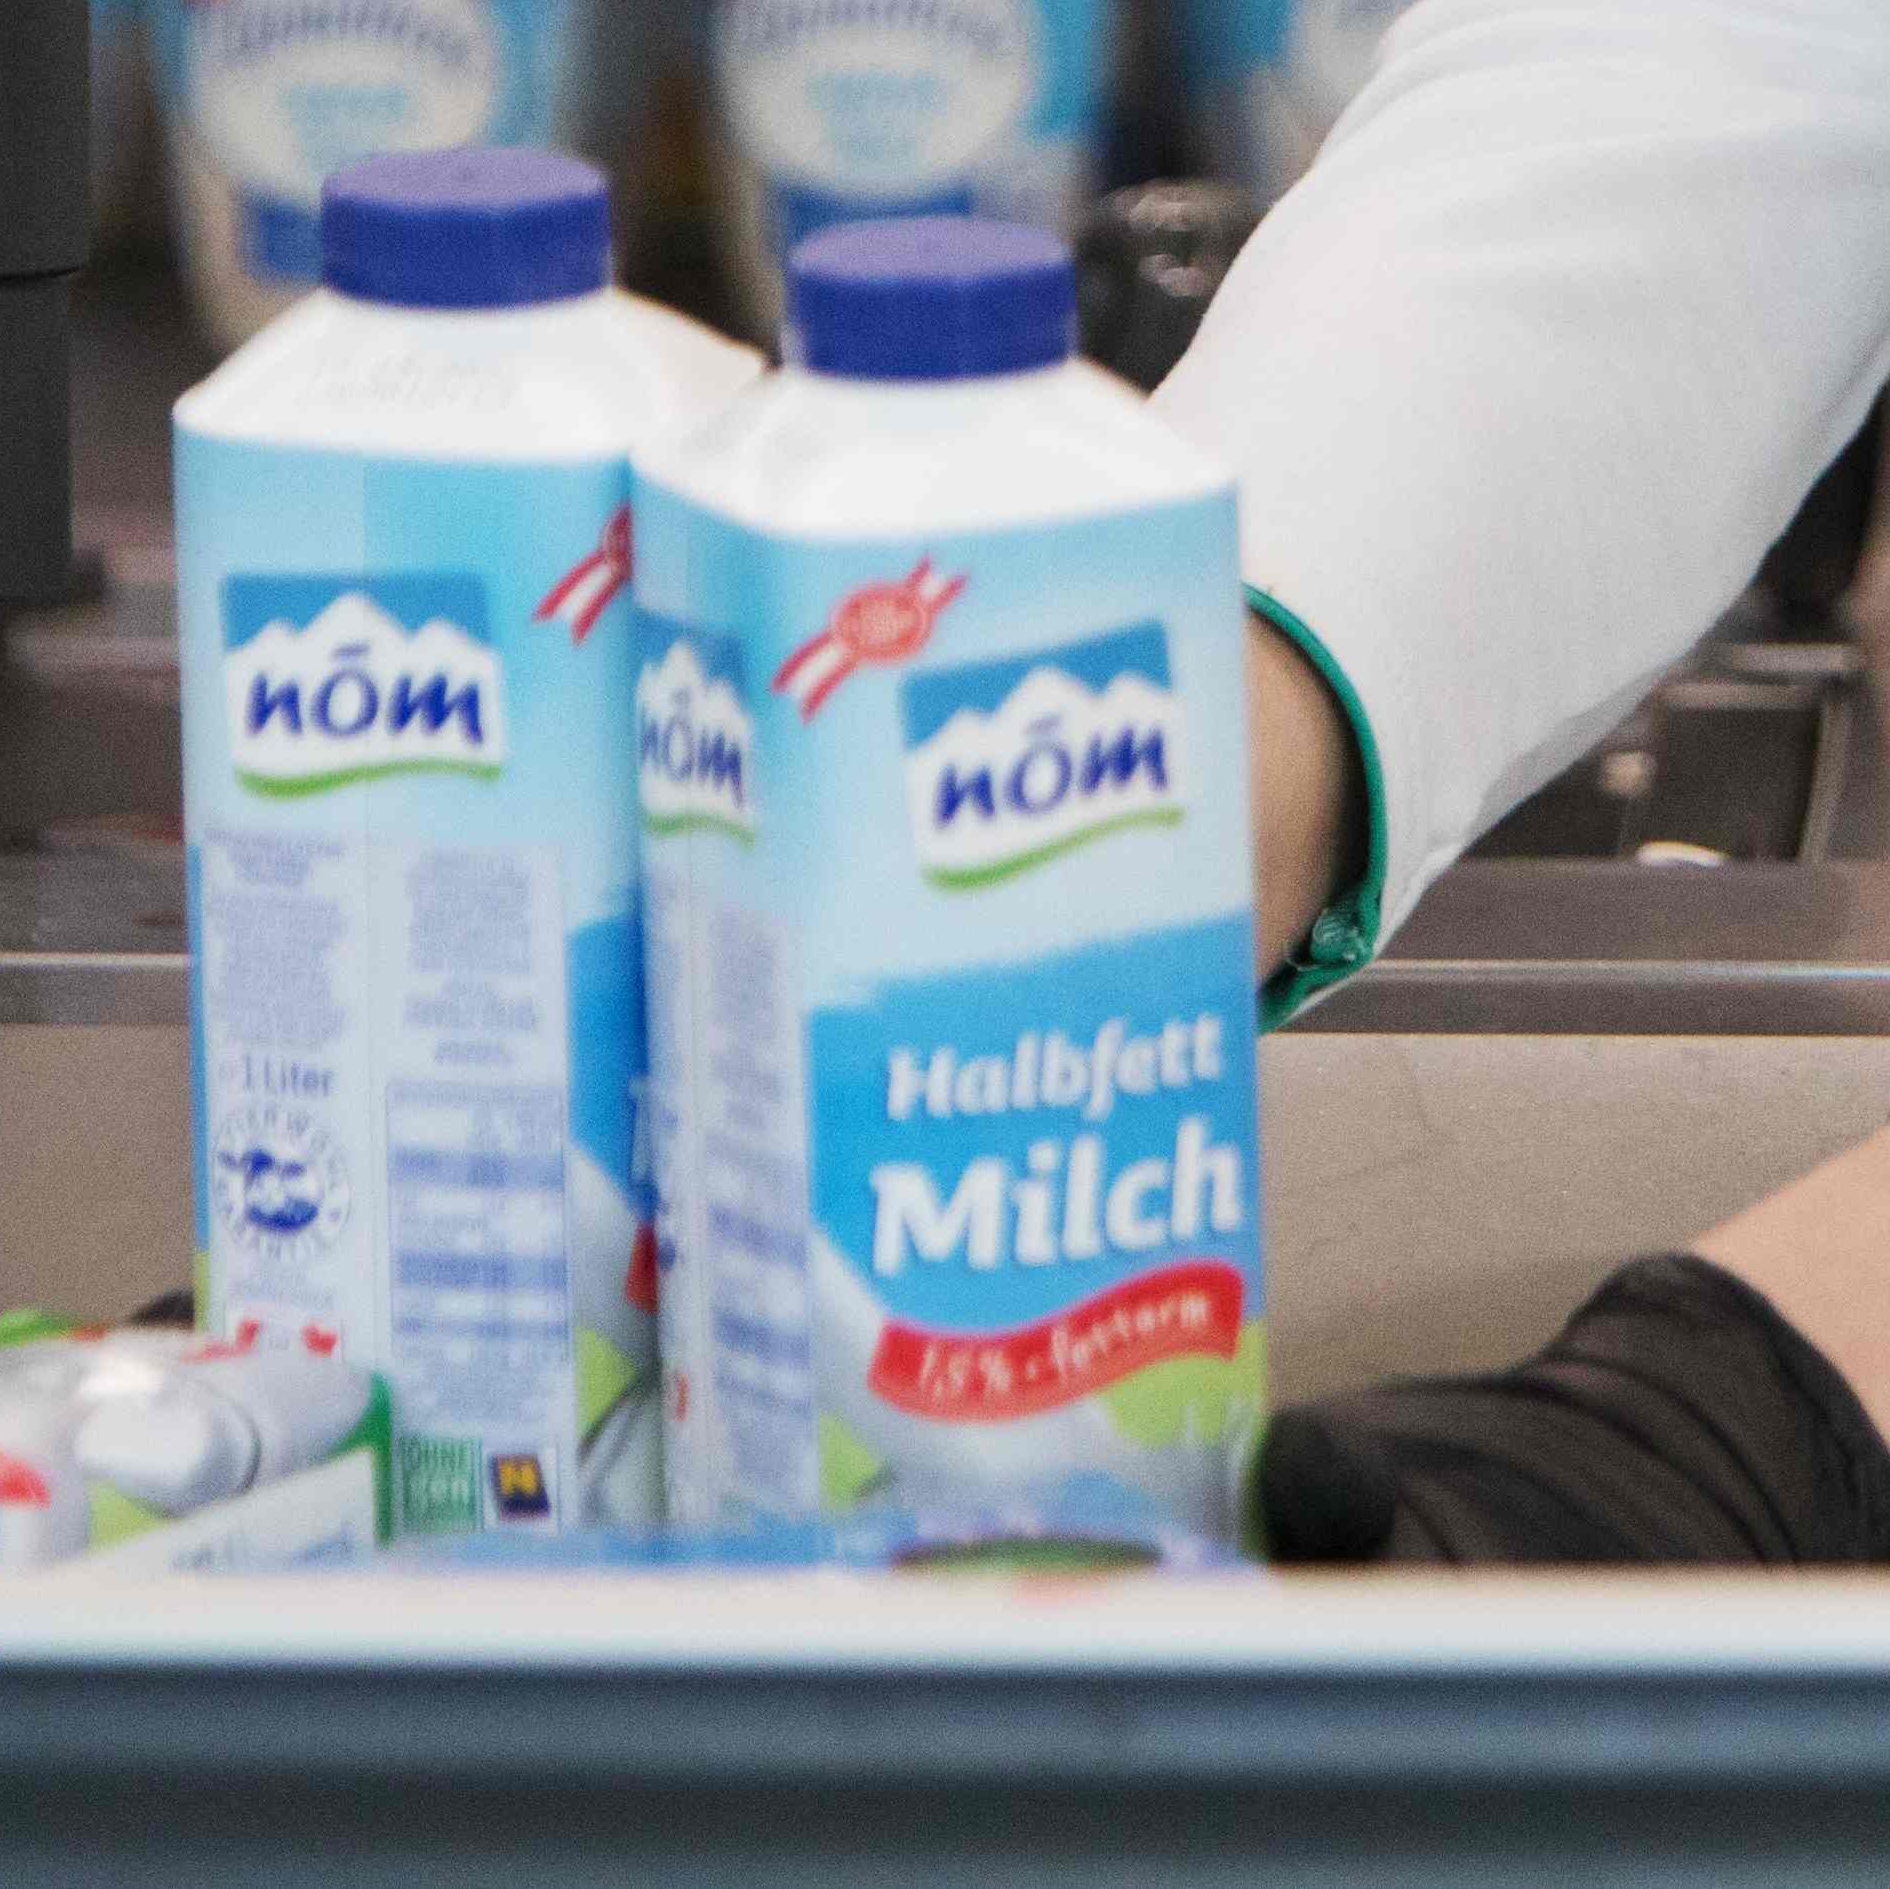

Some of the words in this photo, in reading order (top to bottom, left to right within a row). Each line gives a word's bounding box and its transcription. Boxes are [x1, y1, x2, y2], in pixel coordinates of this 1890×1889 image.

[265, 1059, 334, 1096] Liter
[885, 1014, 1224, 1121] Halbfett
[870, 1116, 1244, 1277] Milch
